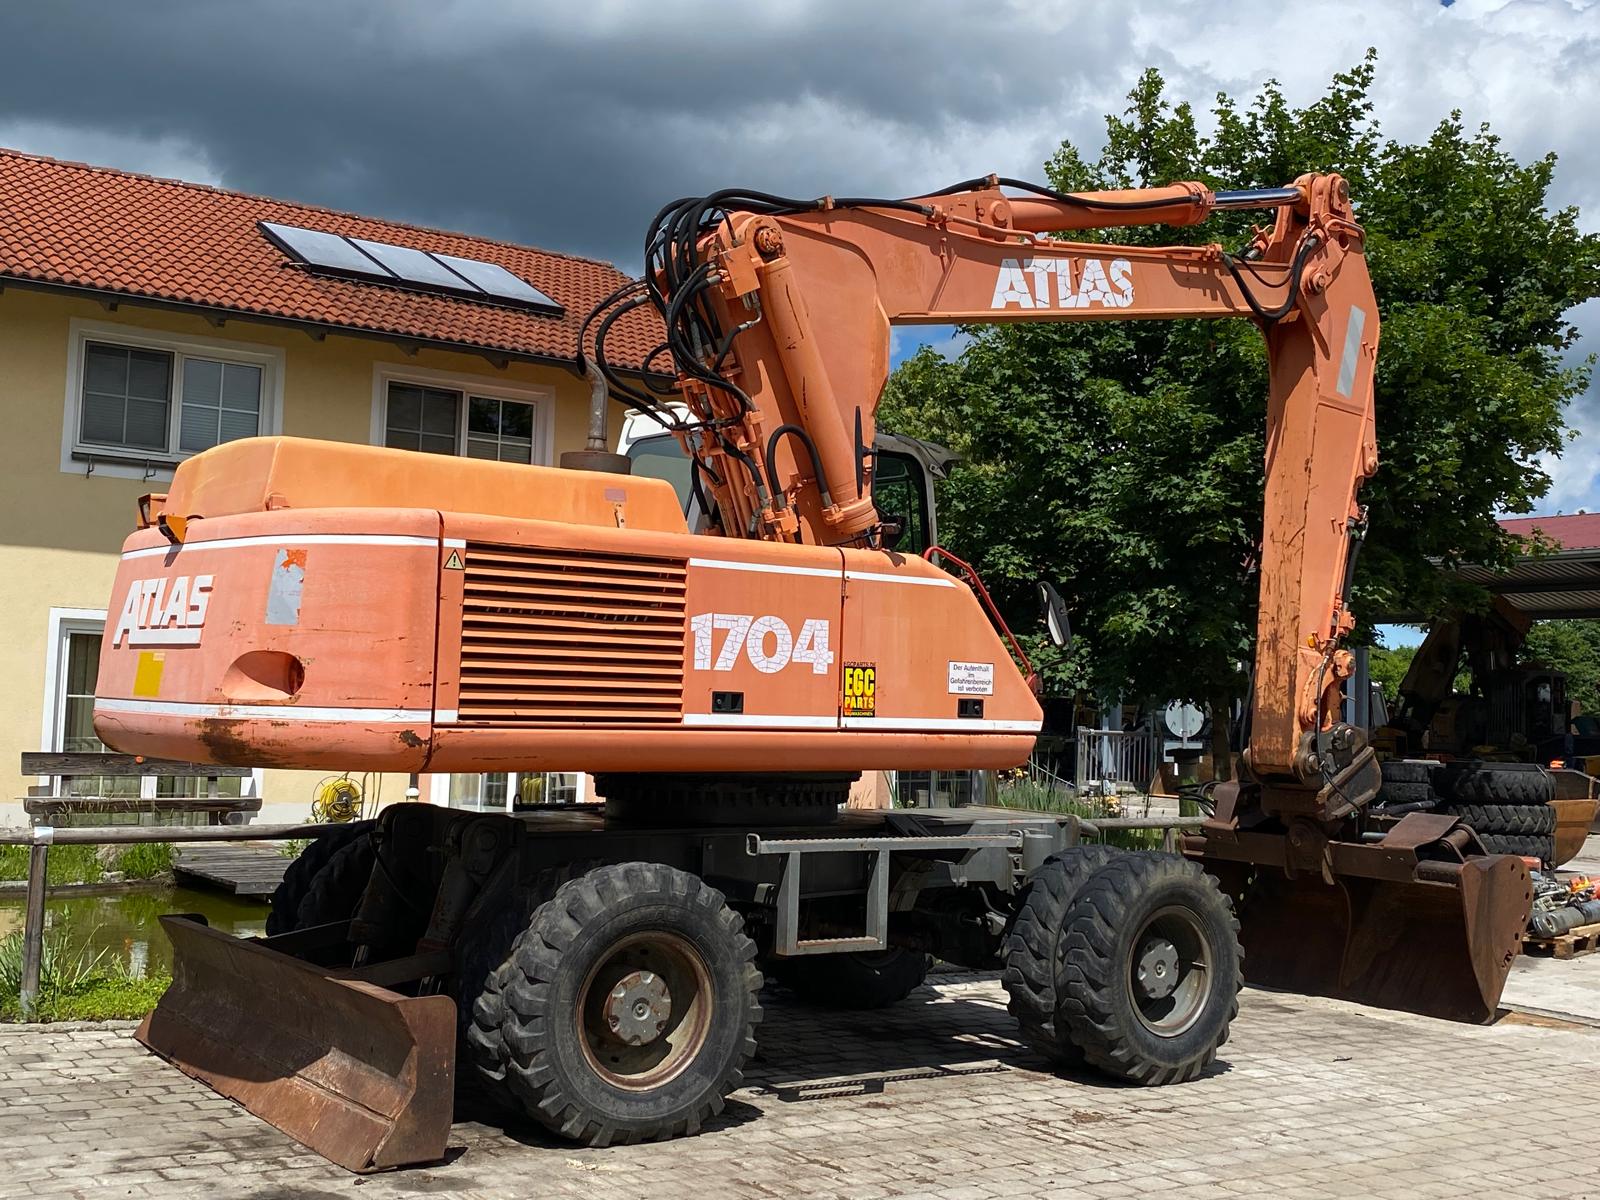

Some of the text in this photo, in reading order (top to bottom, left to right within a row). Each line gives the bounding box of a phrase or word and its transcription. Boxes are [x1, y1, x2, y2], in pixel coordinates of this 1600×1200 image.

[991, 257, 1134, 309] ATLAS
[112, 575, 215, 647] ATLAS
[690, 612, 835, 675] 1704
[845, 667, 875, 697] EGC
[845, 696, 875, 709] PARTS
